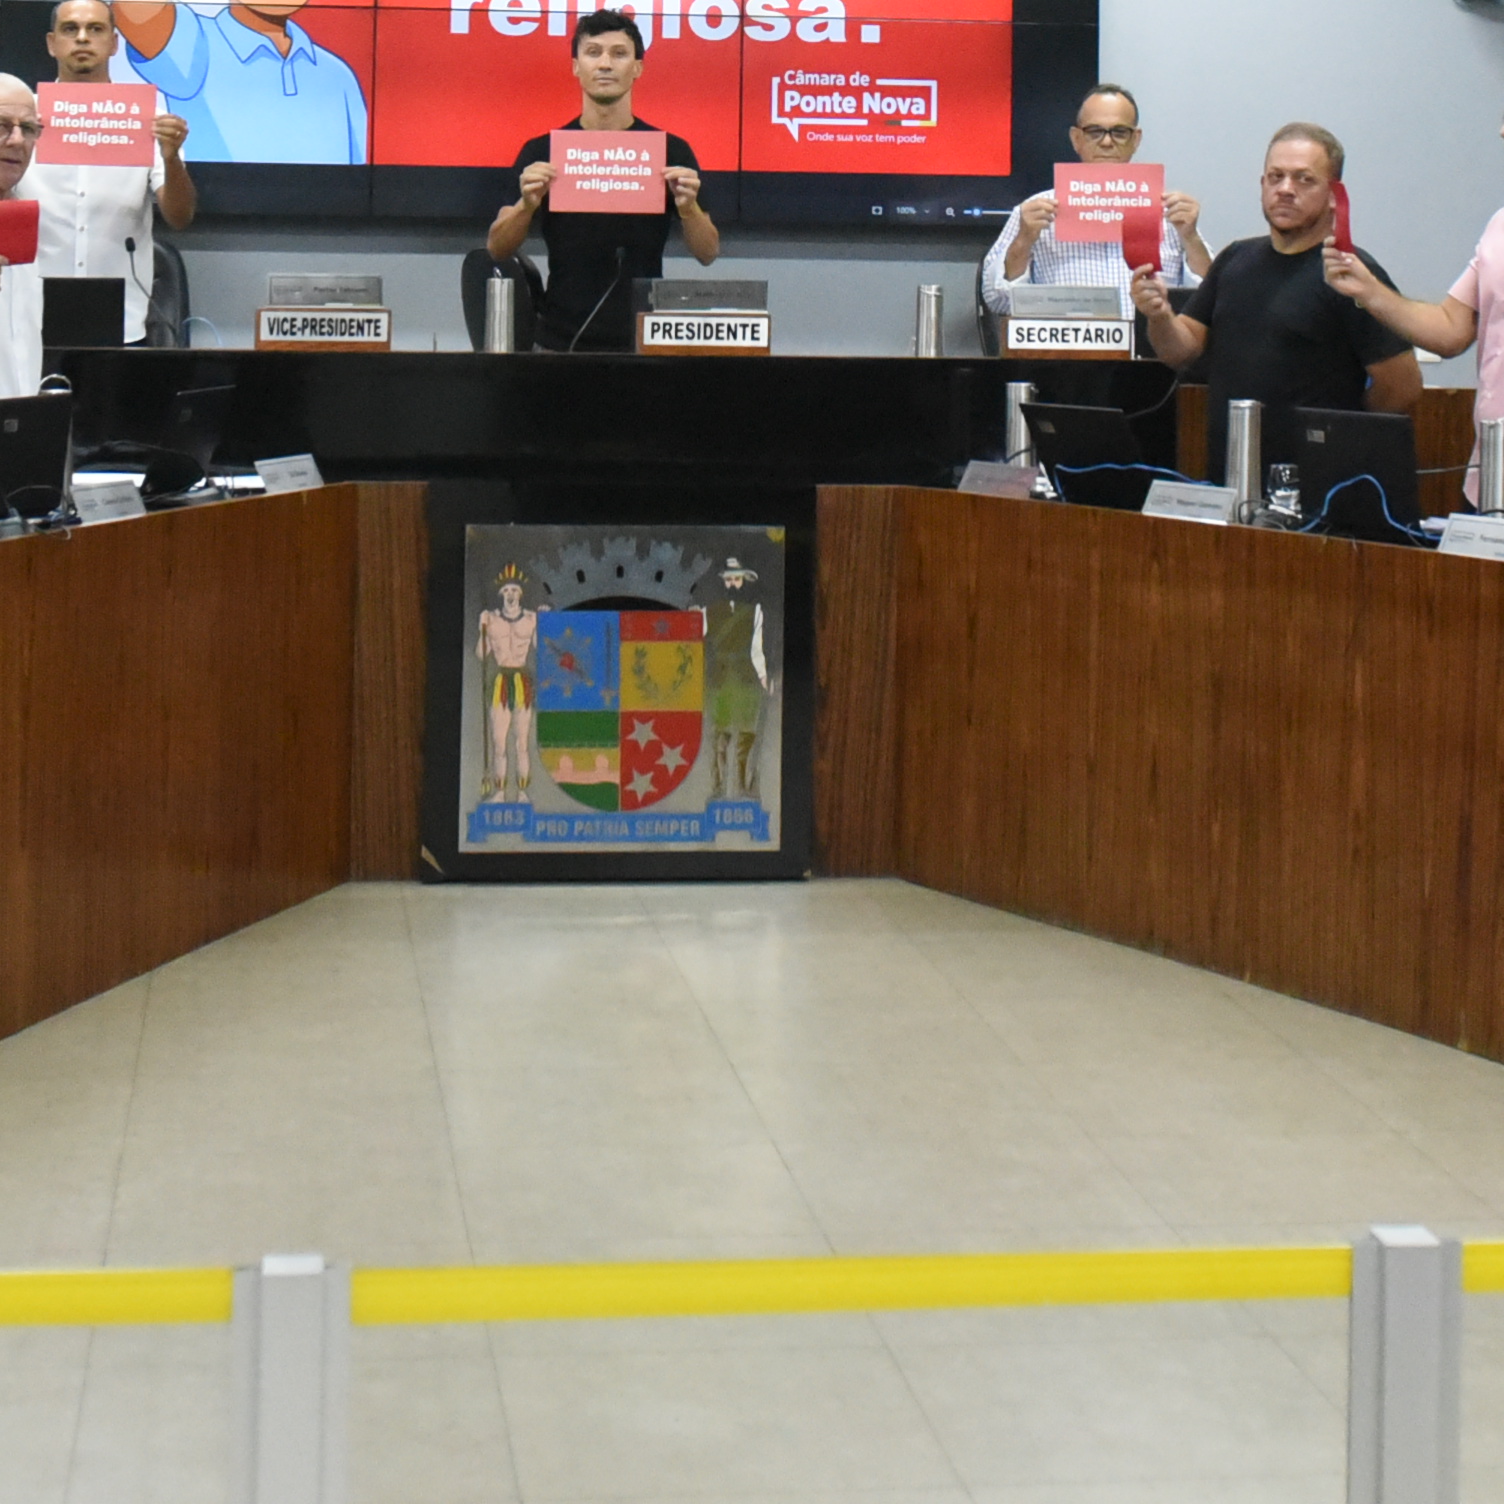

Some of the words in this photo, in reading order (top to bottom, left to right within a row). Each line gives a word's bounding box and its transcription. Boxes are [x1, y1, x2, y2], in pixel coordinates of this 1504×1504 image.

[784, 70, 846, 86] Câmara
[849, 71, 870, 87] de
[53, 101, 88, 115] Diga
[92, 100, 126, 114] NÃO
[784, 90, 857, 113] Ponte
[862, 92, 926, 115] Nova
[50, 116, 142, 130] intolerância
[62, 132, 135, 146] religiosa.
[806, 131, 834, 142] Onde
[836, 134, 854, 142] sua
[855, 134, 873, 143] voz
[875, 133, 895, 143] tem
[897, 134, 927, 145] poder
[566, 148, 600, 162] Diga
[603, 147, 637, 161] NÃO
[564, 163, 652, 176] intolerância
[576, 178, 645, 192] religiosa.
[1069, 181, 1102, 194] Diga
[1105, 179, 1136, 192] NÃO
[1068, 195, 1152, 207] intolerância
[1078, 209, 1125, 223] religio
[267, 317, 382, 337] VICE-PRESIDENTE
[650, 322, 761, 341] PRESIDENTE
[1015, 323, 1124, 344] SECRETÁRIO
[536, 819, 568, 837] PRO
[574, 818, 630, 836] PATRIA
[635, 818, 701, 837] SEMPER
